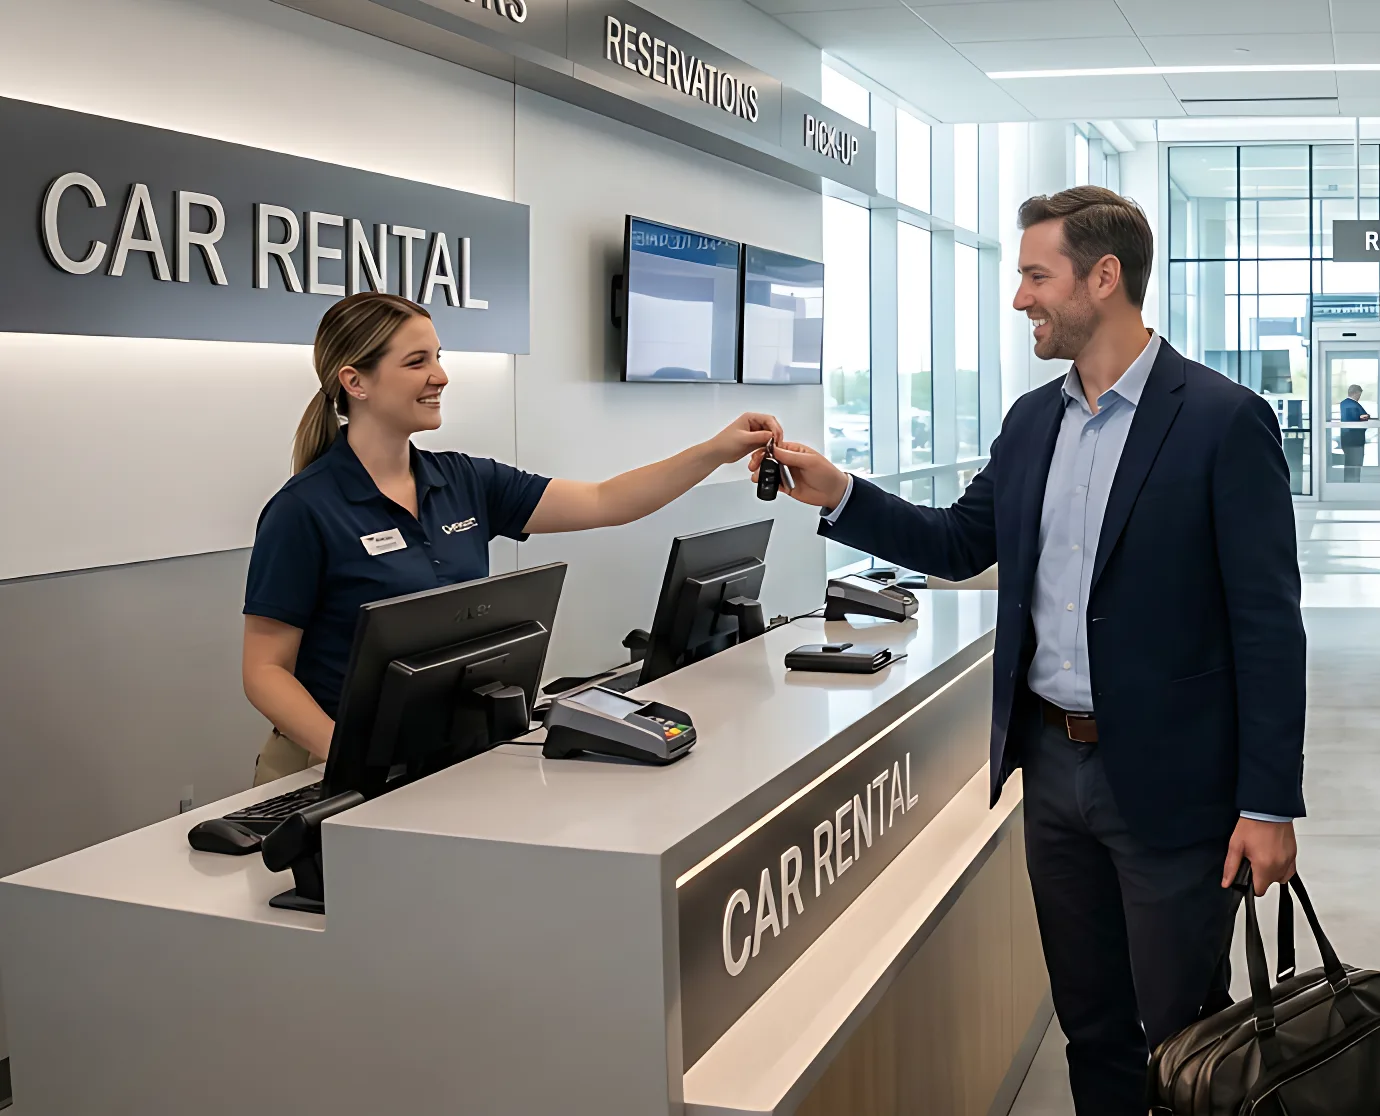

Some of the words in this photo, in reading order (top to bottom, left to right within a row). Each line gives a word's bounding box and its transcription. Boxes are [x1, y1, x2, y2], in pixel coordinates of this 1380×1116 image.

[605, 15, 759, 123] RESERVATIONS
[803, 113, 858, 166] PICK-UP
[41, 171, 229, 286] CAR
[252, 202, 489, 310] RENTAL
[722, 845, 804, 977] CAR
[813, 752, 919, 898] RENTAL
